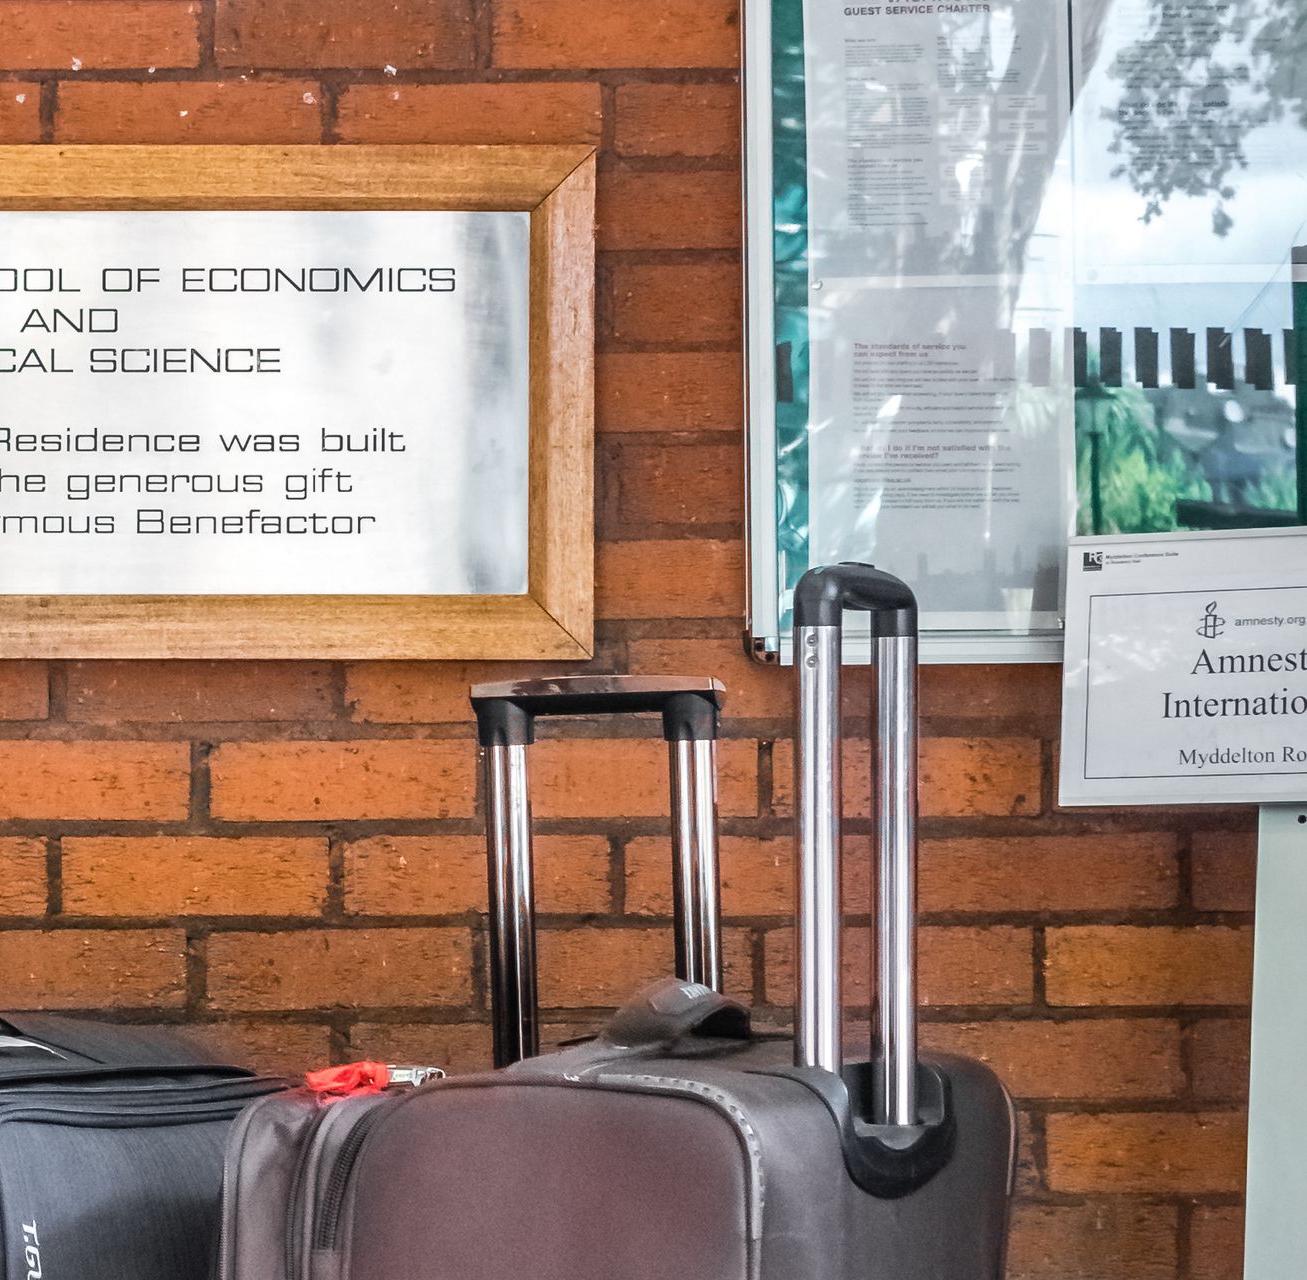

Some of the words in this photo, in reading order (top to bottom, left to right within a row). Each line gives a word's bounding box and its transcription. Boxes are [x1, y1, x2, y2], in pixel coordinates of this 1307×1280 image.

[844, 6, 882, 16] GUEST
[885, 5, 934, 15] SERVICE
[937, 4, 990, 13] CHARTER
[102, 268, 159, 292] OF
[183, 268, 455, 292] ECONOMICS
[21, 309, 118, 332] AND
[90, 348, 280, 372] SCIENCE
[220, 435, 299, 452] was
[322, 428, 405, 451] built
[68, 475, 262, 500] generous
[286, 468, 352, 500] gift
[137, 509, 375, 534] Benefactor
[1190, 648, 1307, 675] Amnest
[1162, 687, 1307, 719] Internatio
[1179, 747, 1275, 768] Myddelton
